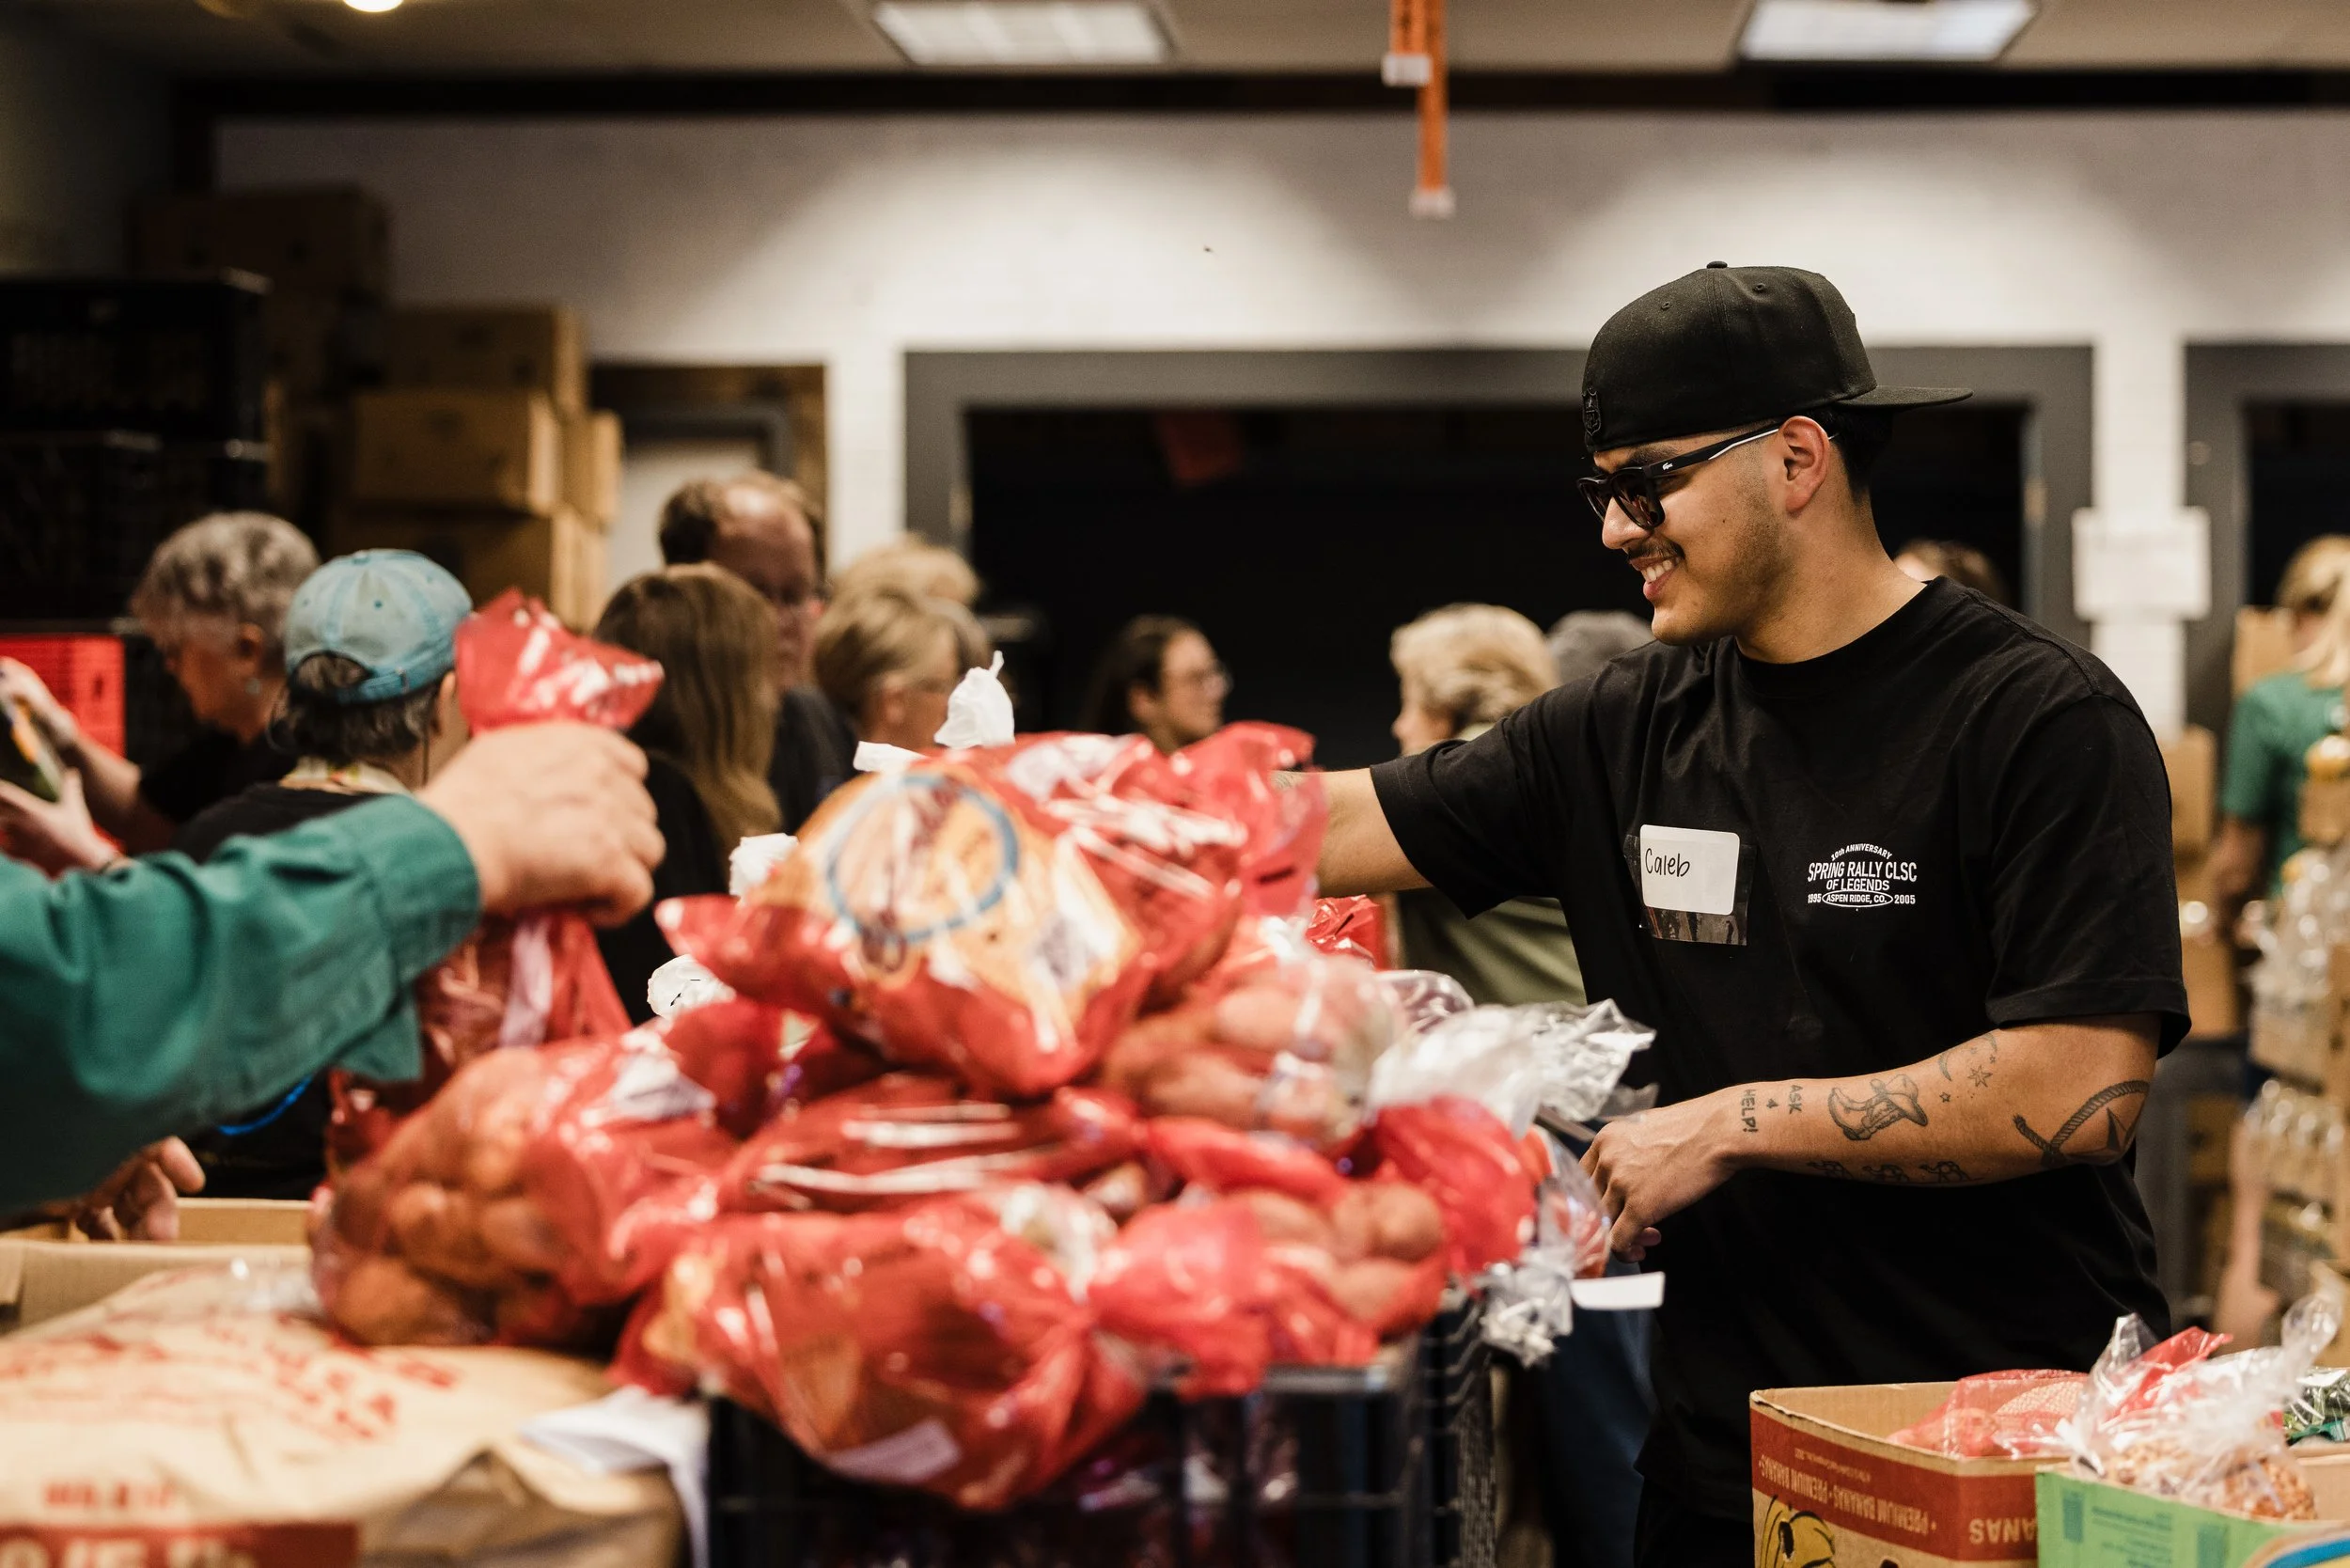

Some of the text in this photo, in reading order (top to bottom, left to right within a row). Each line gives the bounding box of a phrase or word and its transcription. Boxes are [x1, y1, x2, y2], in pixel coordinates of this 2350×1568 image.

[1845, 843, 1893, 860] ANNIVERSARY
[1645, 848, 1691, 878] Caleb
[1808, 861, 1918, 882] SPRING RALLY CLSC
[1825, 878, 1890, 891] OF LEGENDS
[1807, 893, 1916, 904] 1995 ASPEN RIDGE, CO. 2005
[1788, 1084, 1804, 1115] ASK
[1741, 1089, 1759, 1133] HELP!
